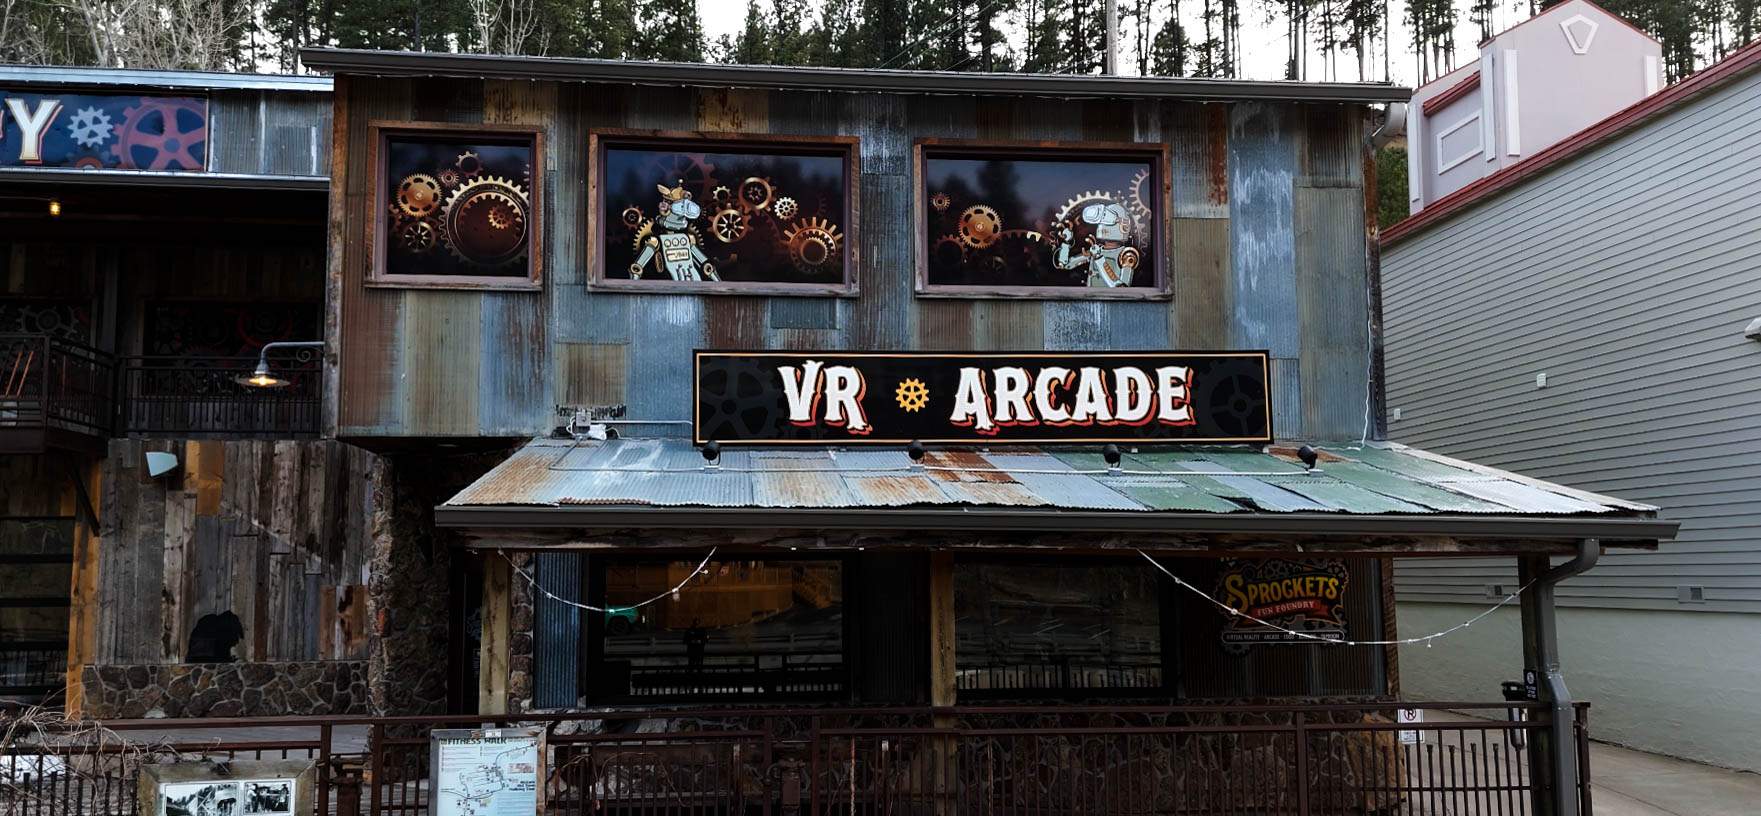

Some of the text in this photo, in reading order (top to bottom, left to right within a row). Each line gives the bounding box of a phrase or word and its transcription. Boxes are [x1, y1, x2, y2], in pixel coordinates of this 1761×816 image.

[777, 359, 1196, 436] VR ARCADE
[1225, 574, 1339, 614] SPROCKETS
[1275, 600, 1315, 613] FOUNDRY
